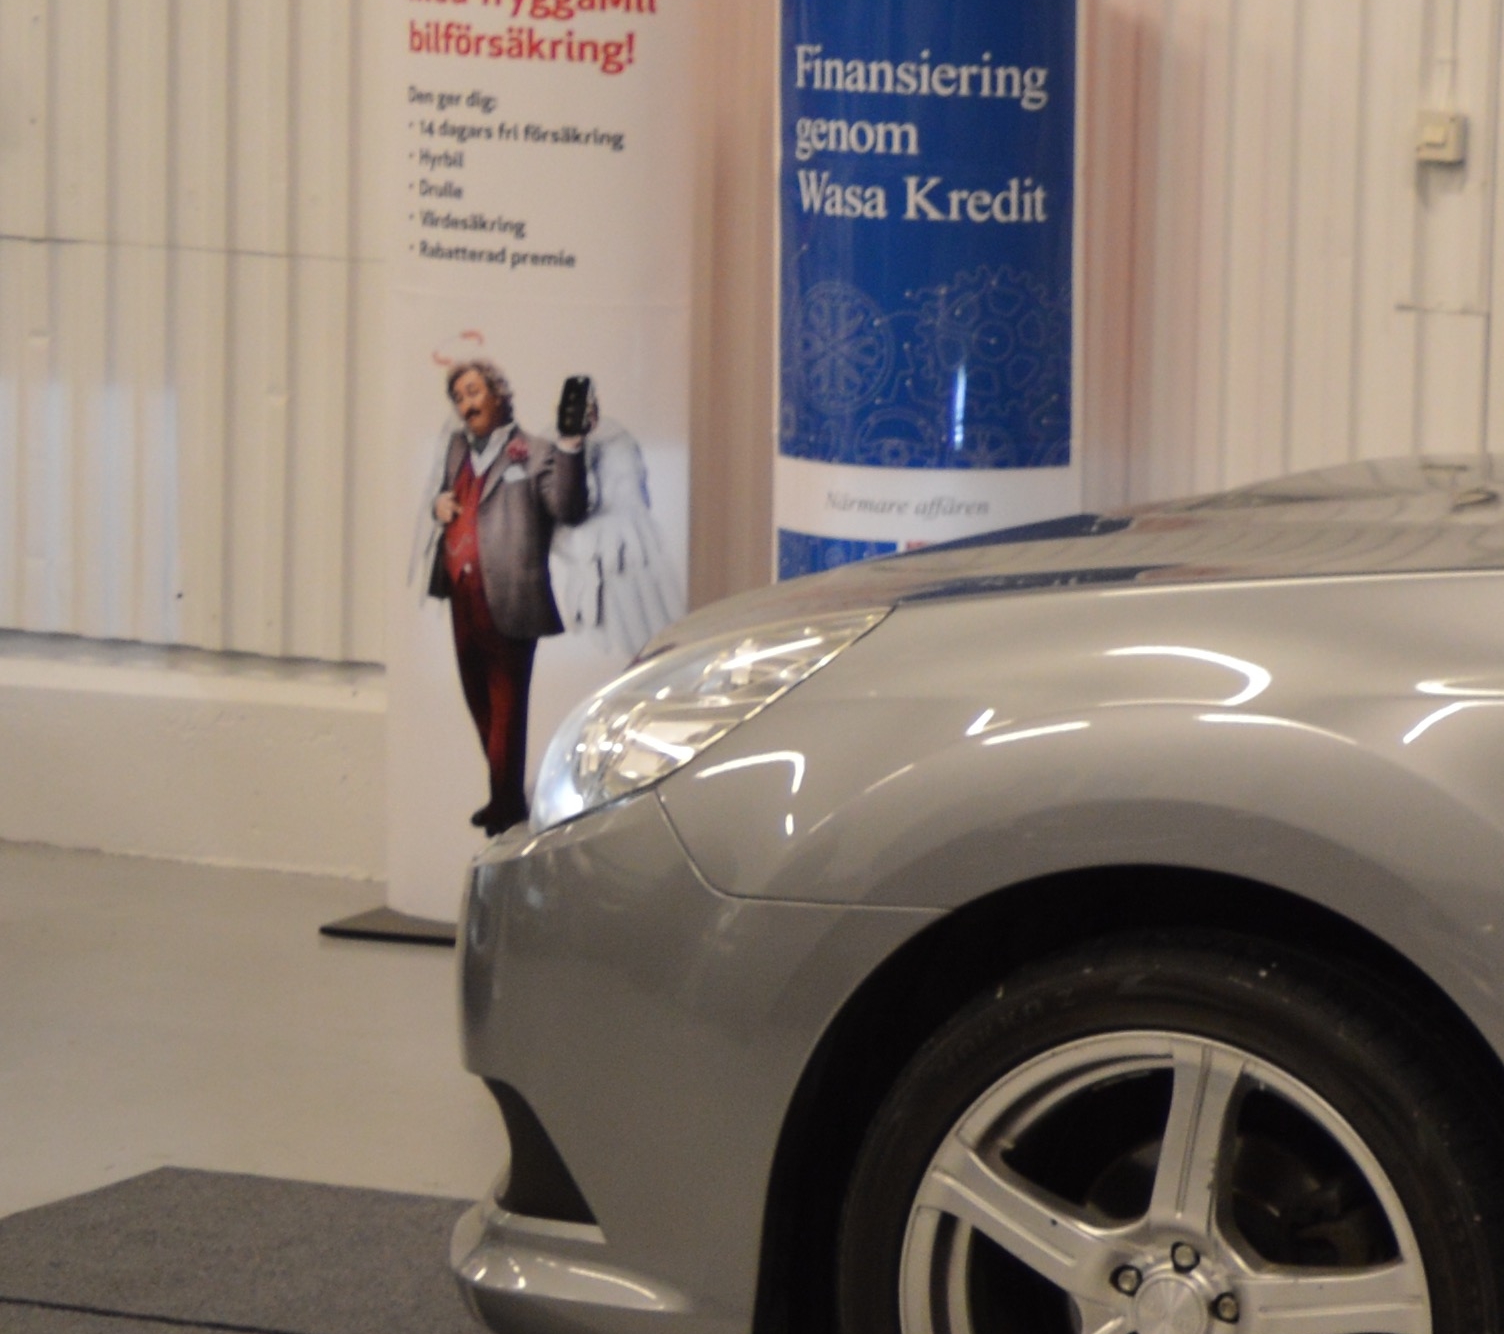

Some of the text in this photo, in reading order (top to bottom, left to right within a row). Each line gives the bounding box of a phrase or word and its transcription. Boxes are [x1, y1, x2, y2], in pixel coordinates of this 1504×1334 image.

[408, 20, 636, 75] bilförsäkring!
[795, 44, 1049, 110] Finansiering
[439, 120, 493, 143] dagars
[524, 124, 624, 151] försäkring
[795, 117, 919, 161] genom
[798, 169, 1047, 223] Wasa Kredit
[419, 240, 576, 268] Rabatterad premie
